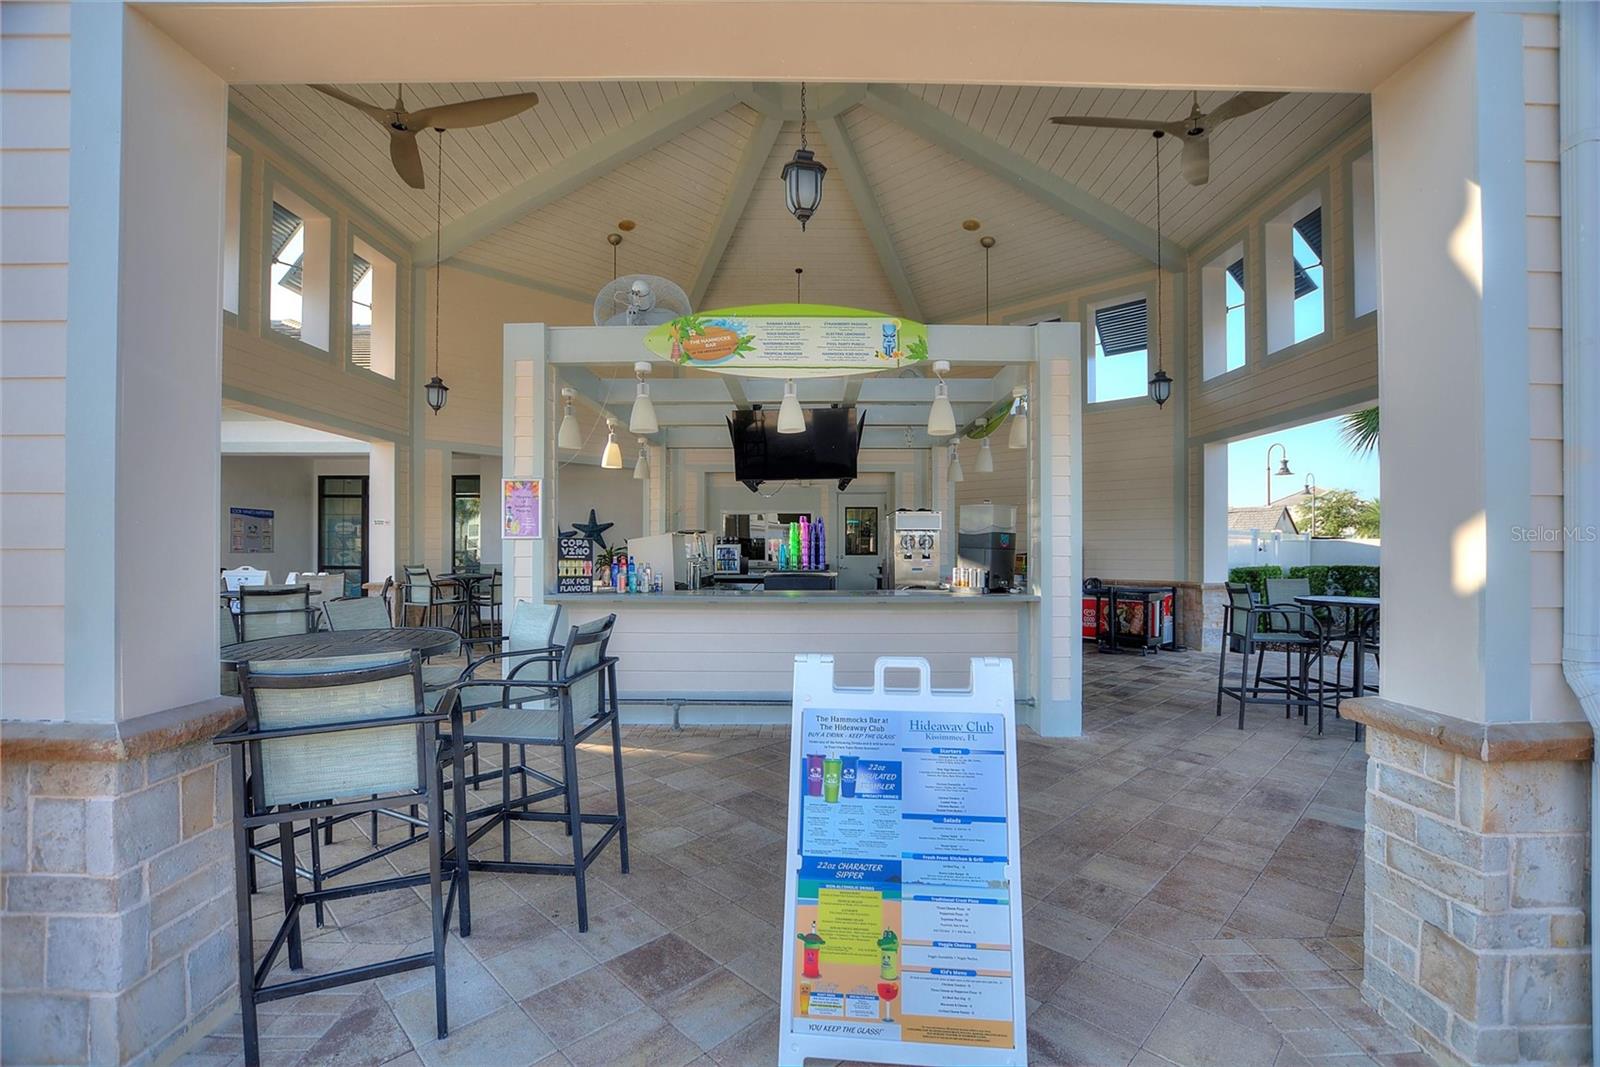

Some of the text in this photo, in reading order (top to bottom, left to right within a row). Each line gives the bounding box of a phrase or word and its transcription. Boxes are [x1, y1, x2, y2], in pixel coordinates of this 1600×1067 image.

[561, 539, 589, 547] COPA
[835, 724, 867, 732] Hideaway
[909, 720, 994, 732] Hideaway Club
[837, 862, 883, 872] CHARACTER
[835, 871, 864, 879] SIPPER
